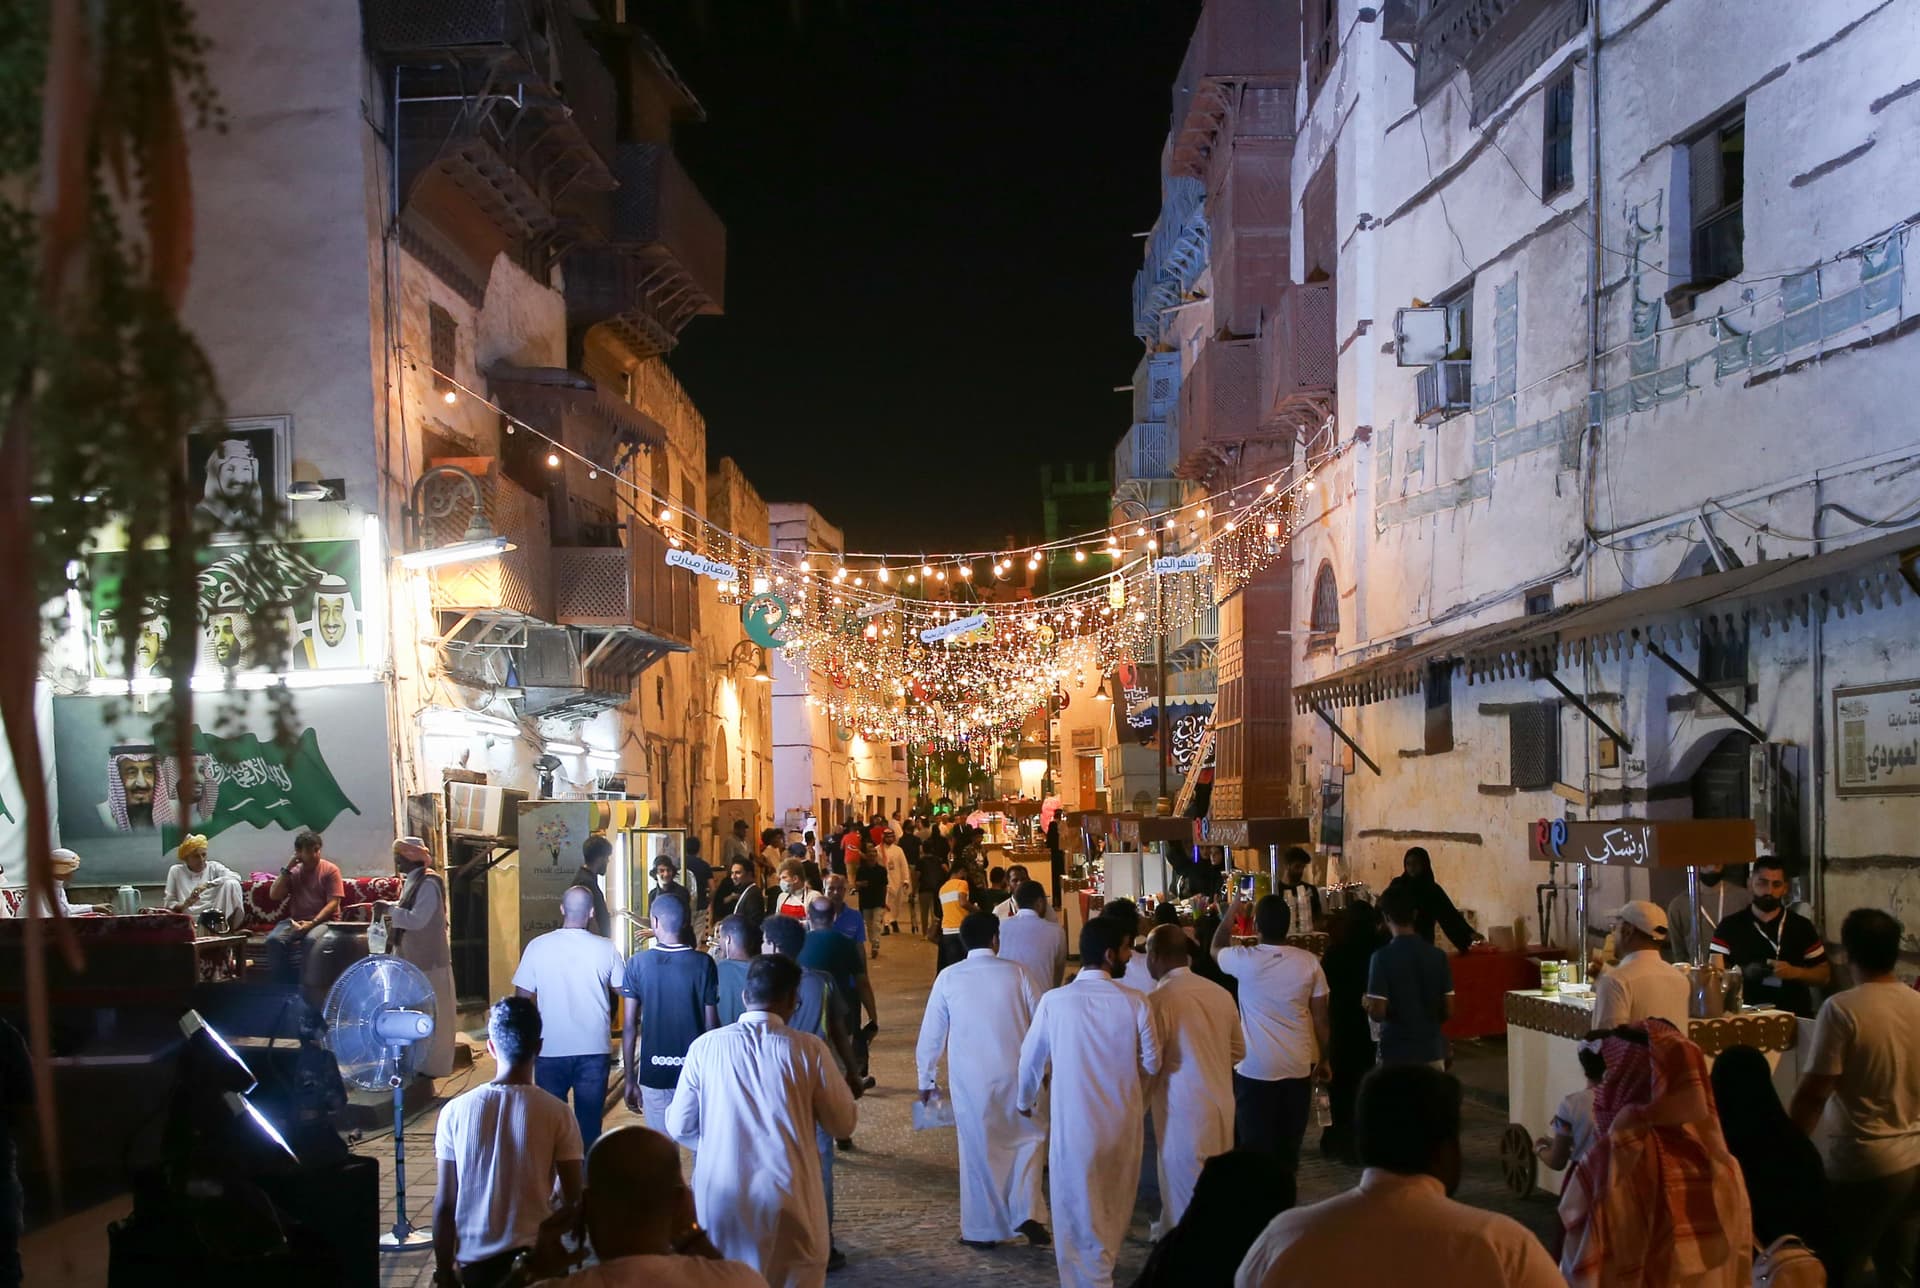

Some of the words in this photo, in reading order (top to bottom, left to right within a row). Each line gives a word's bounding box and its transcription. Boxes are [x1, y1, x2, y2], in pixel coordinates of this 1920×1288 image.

[671, 554, 701, 568] مبارك
[1156, 557, 1176, 571] الخير
[1176, 556, 1197, 570] شهر
[702, 564, 734, 579] رمضان
[1867, 738, 1918, 781] لعمودي
